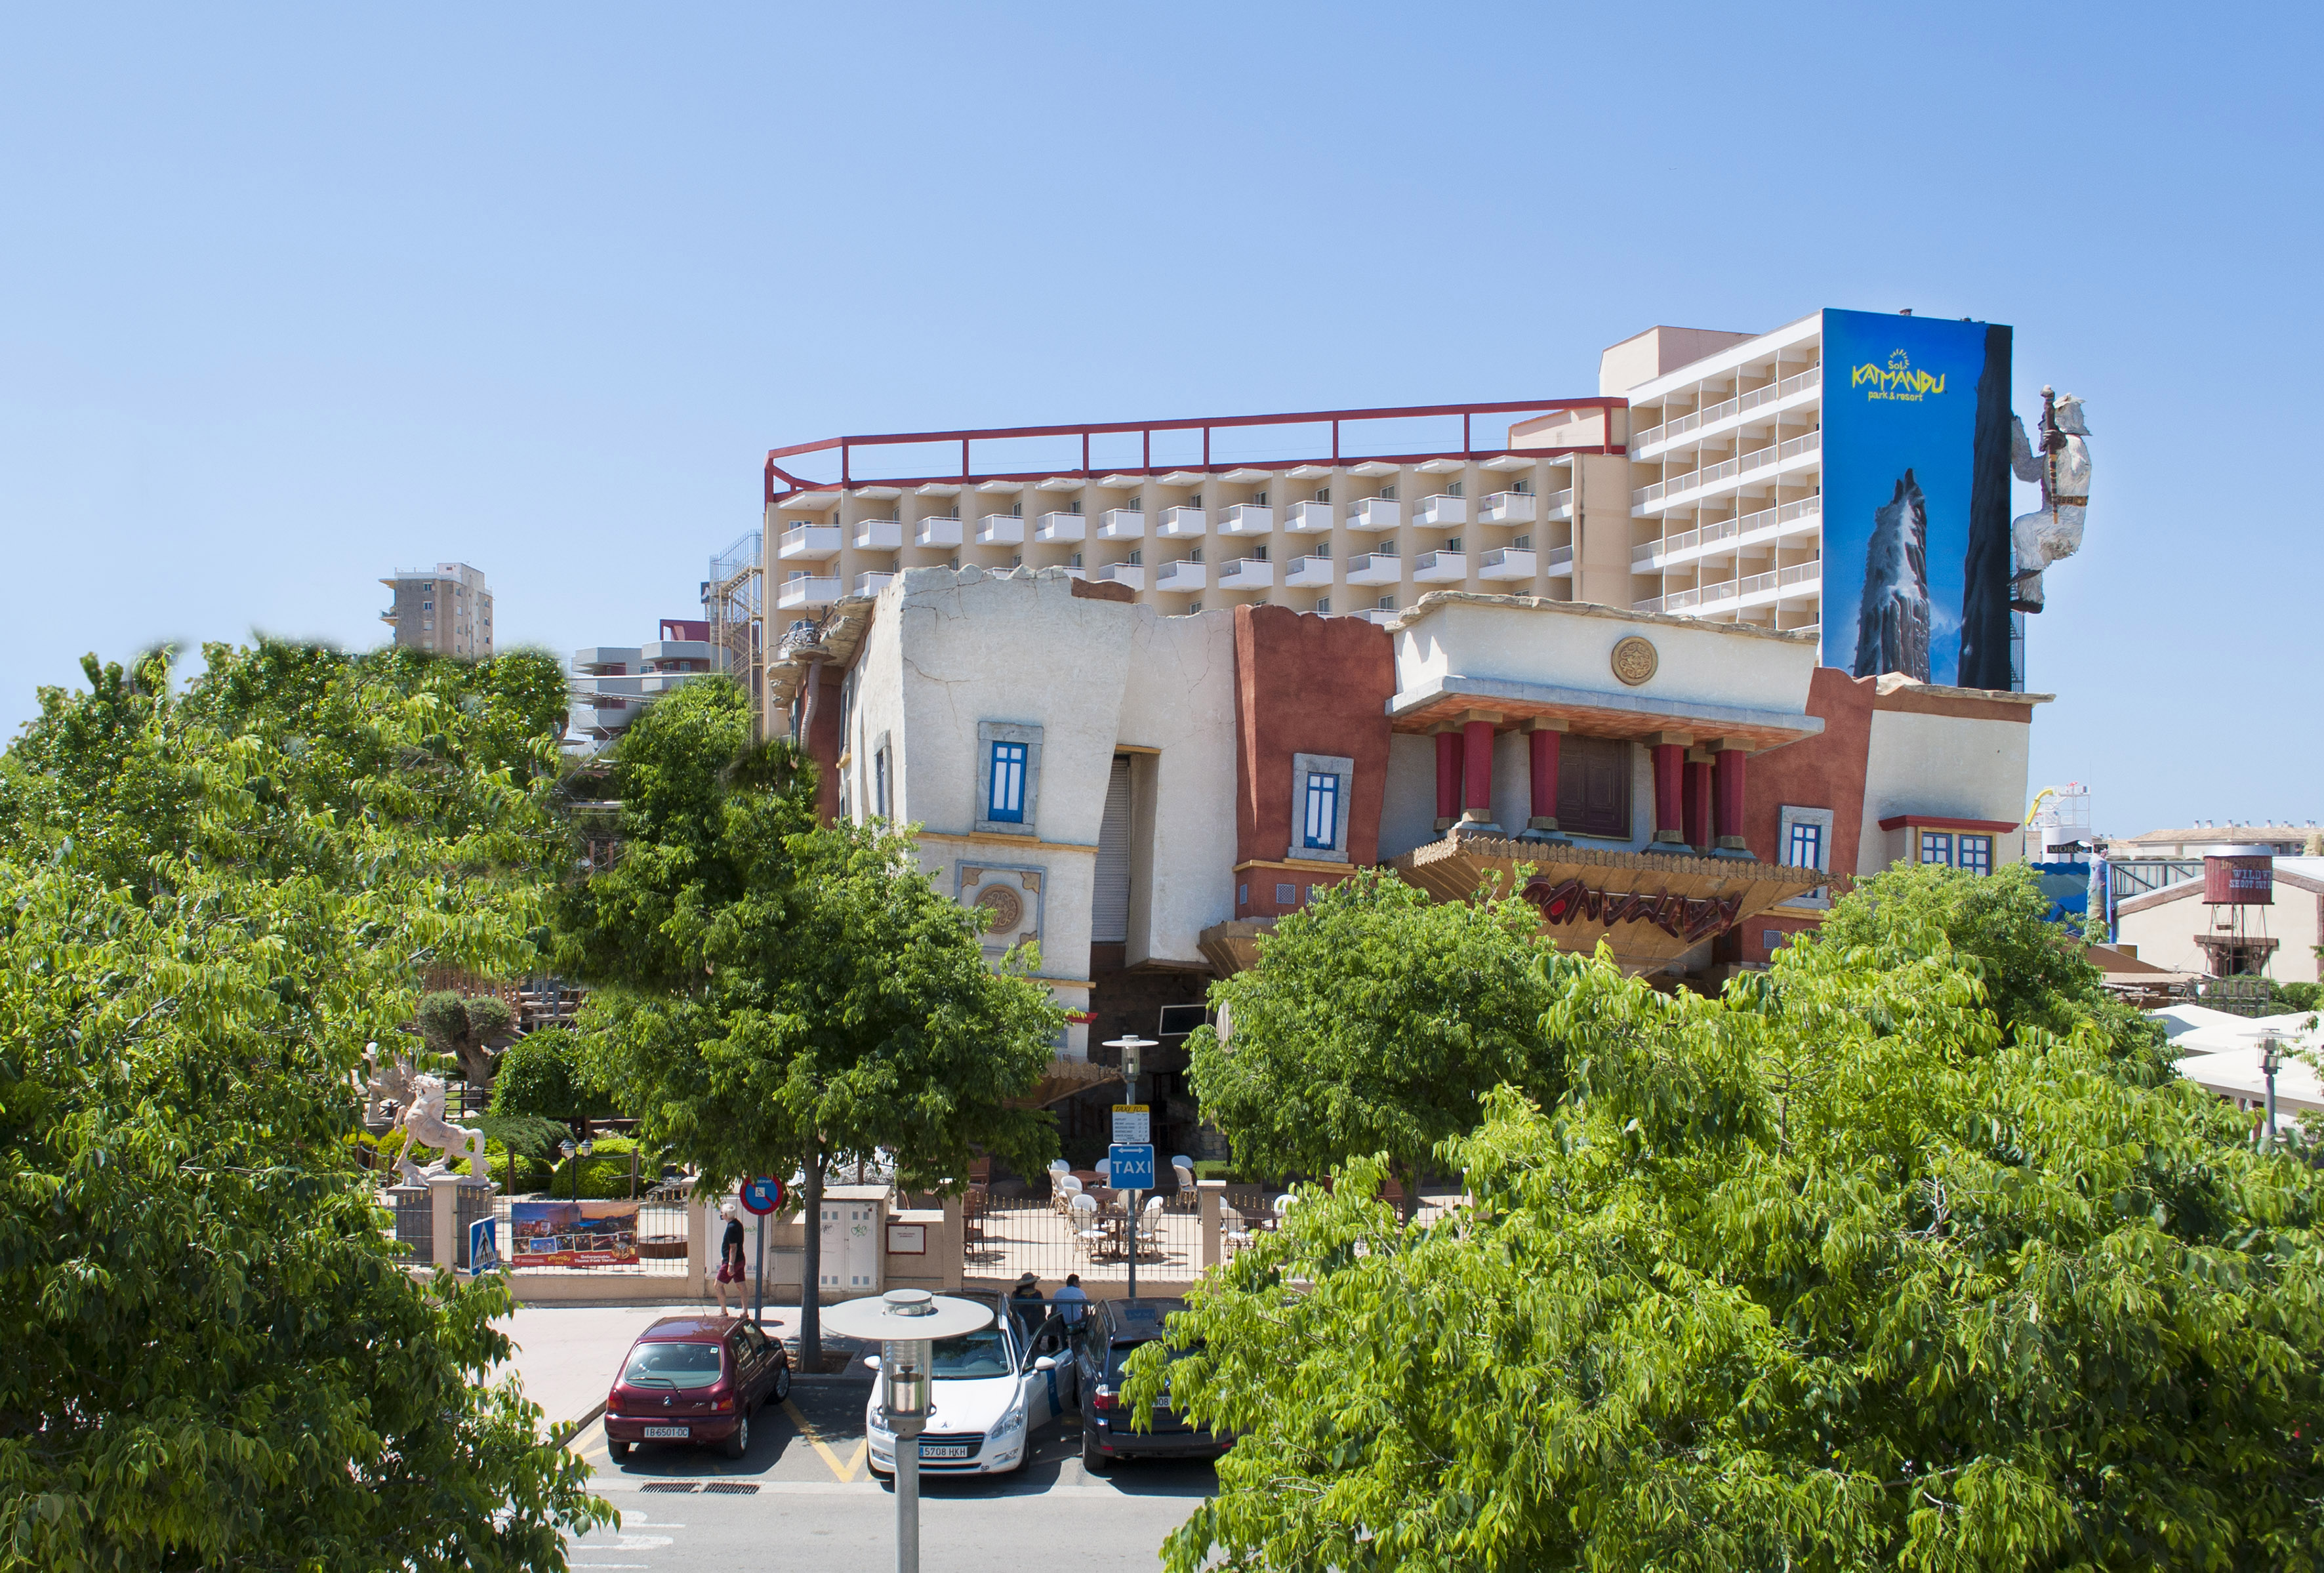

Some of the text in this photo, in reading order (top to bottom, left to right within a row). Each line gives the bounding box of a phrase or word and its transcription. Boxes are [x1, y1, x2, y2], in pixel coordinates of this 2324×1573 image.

[1852, 363, 1945, 394] KATMANDU
[1868, 391, 1923, 402] park & resort
[2232, 869, 2261, 880] WILD
[2229, 880, 2254, 889] SHOOT
[1112, 1160, 1151, 1174] TAXI
[647, 1428, 688, 1437] IB-6501-DC
[925, 1447, 946, 1456] 5708
